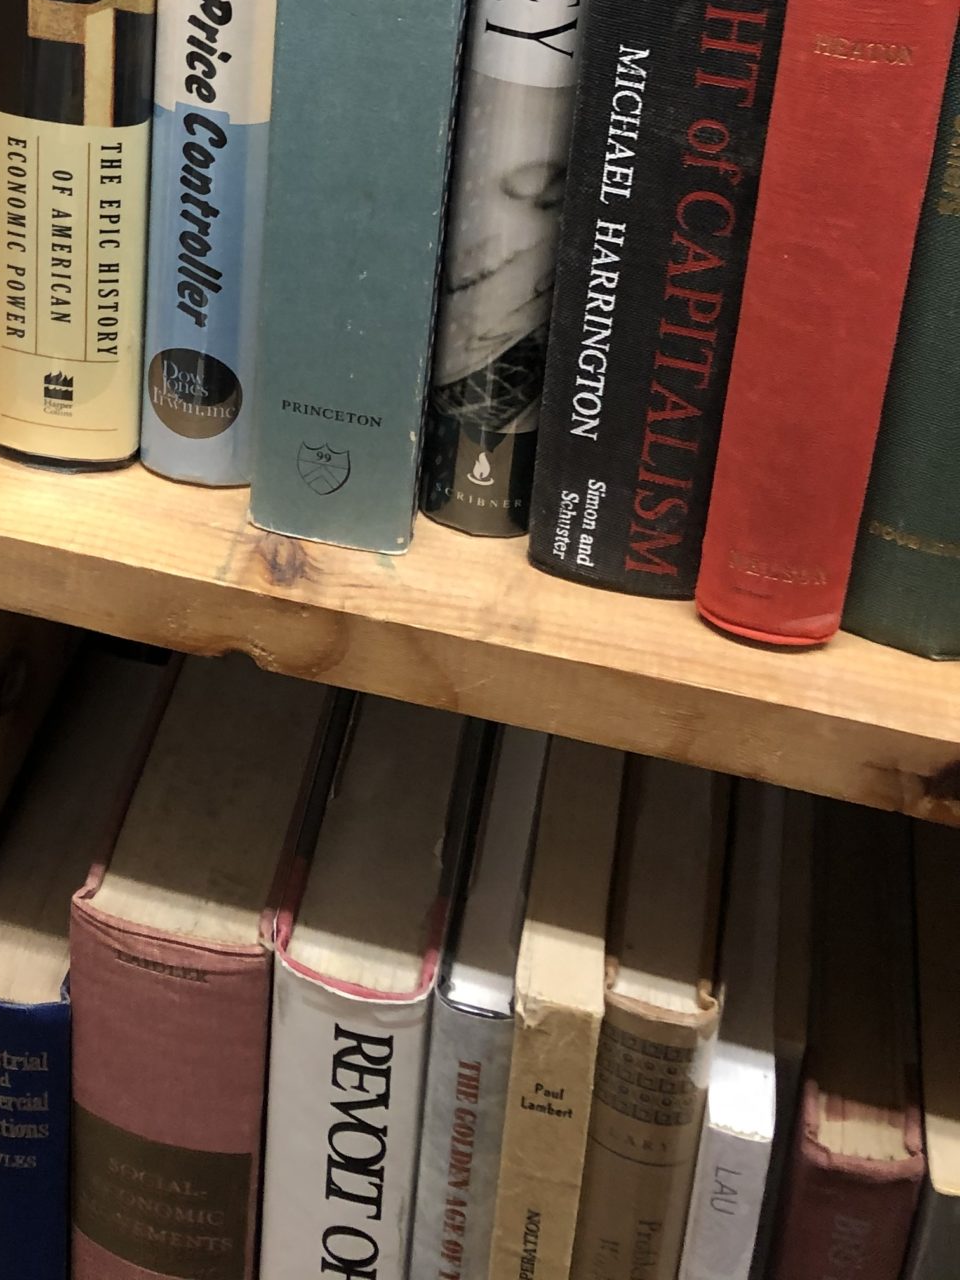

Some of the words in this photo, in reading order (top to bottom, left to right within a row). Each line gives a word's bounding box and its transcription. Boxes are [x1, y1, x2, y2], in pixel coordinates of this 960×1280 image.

[598, 42, 651, 206] MICHAEL
[100, 142, 124, 186] THE
[681, 120, 746, 183] of
[6, 135, 28, 256] ECONOMIC
[52, 169, 74, 197] OF
[99, 197, 121, 250] EPIC
[176, 113, 228, 329] Controller
[49, 206, 74, 325] AMERICAN
[4, 261, 28, 340] POWER
[95, 258, 120, 357] HISTORY
[569, 217, 628, 442] HARRINGTON
[162, 359, 204, 385] Dow
[625, 183, 736, 579] CAPITALISM
[43, 399, 73, 410] Harper
[281, 399, 383, 428] PRINCETON
[316, 450, 332, 463] 99
[435, 482, 523, 509] SCRIBNER
[586, 477, 608, 528] Simon
[553, 487, 581, 561] Schuster
[575, 529, 596, 569] and
[455, 1059, 482, 1105] THE
[520, 1095, 573, 1119] Lambert
[533, 1082, 565, 1101] Paul
[324, 1022, 395, 1223] REVOLT
[447, 1106, 478, 1192] GOLDEN
[709, 1165, 743, 1216] LAU
[442, 1195, 468, 1238] AGE
[440, 1239, 465, 1269] OF
